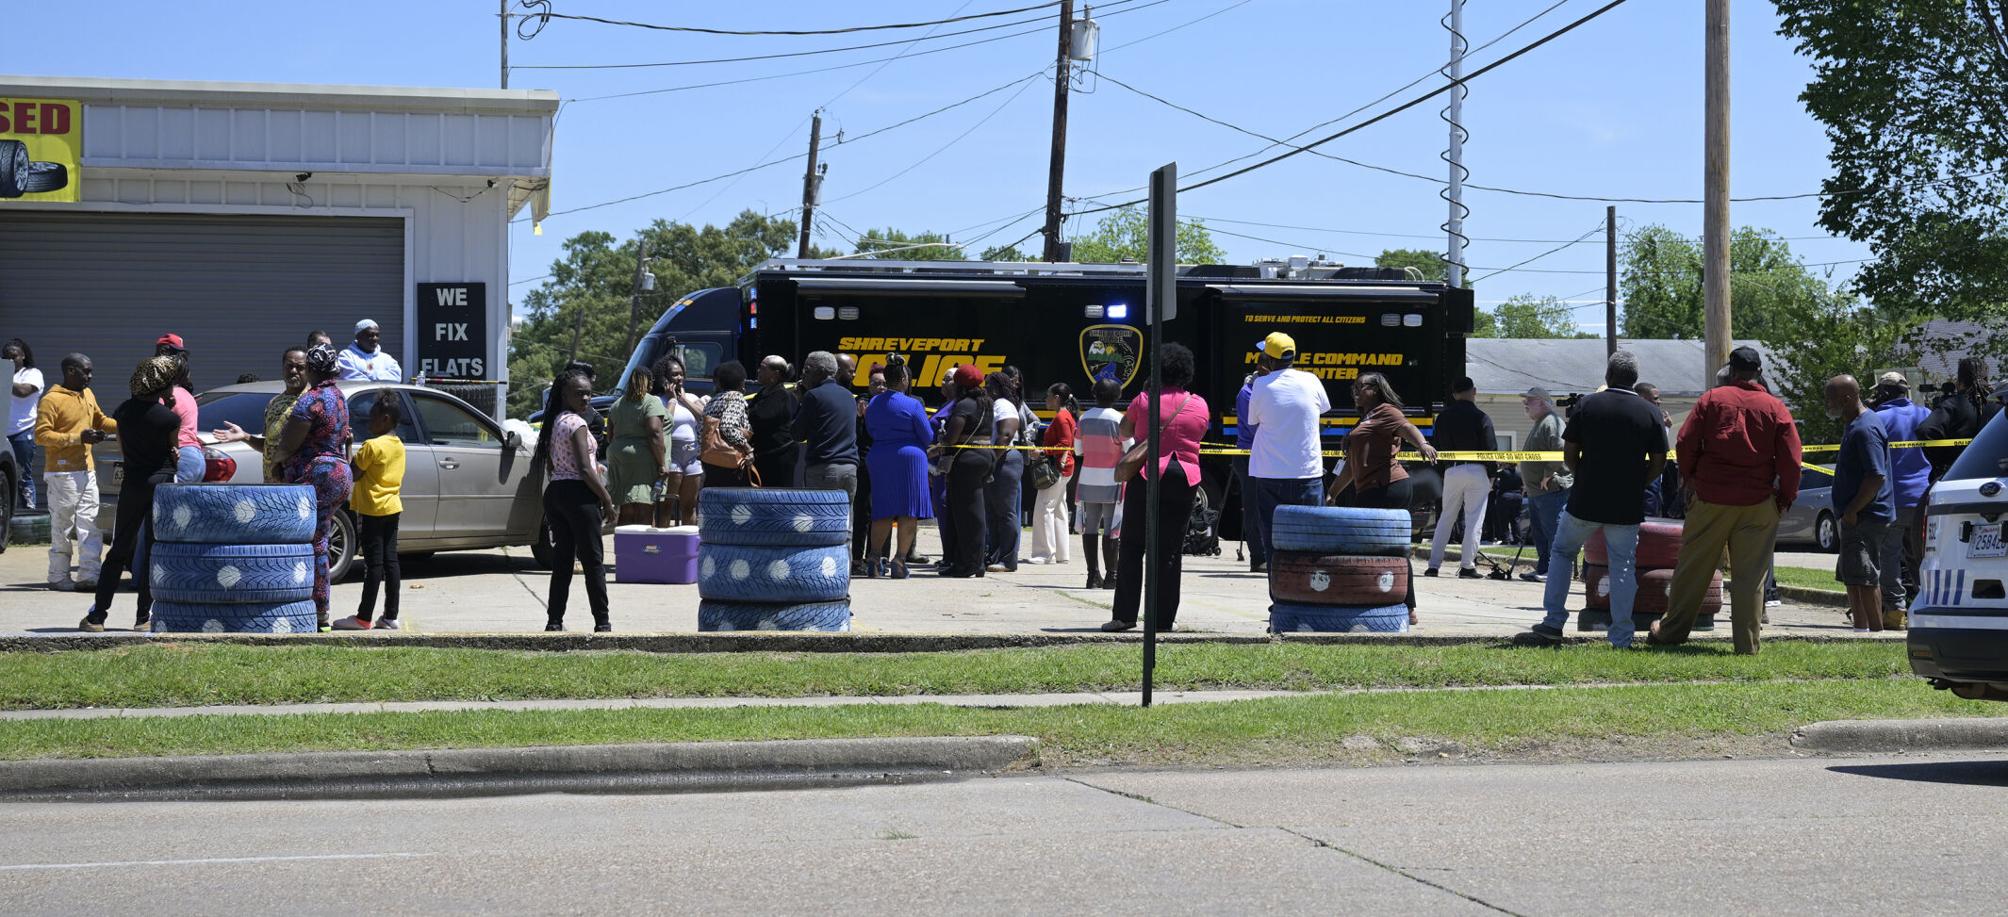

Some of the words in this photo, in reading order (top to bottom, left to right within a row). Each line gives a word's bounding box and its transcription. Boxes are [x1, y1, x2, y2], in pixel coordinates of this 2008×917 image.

[436, 288, 468, 306] WE
[1254, 315, 1276, 323] SERVE
[1276, 315, 1290, 323] AND
[1291, 315, 1321, 323] PROTECT
[1321, 316, 1334, 324] ALL
[1335, 316, 1366, 324] CITIZENS
[435, 323, 468, 341] FIX
[838, 337, 985, 352] SHREVEPORT
[421, 357, 484, 376] FLATS
[1313, 352, 1403, 366] COMMAND
[1476, 452, 1494, 460] POLICE
